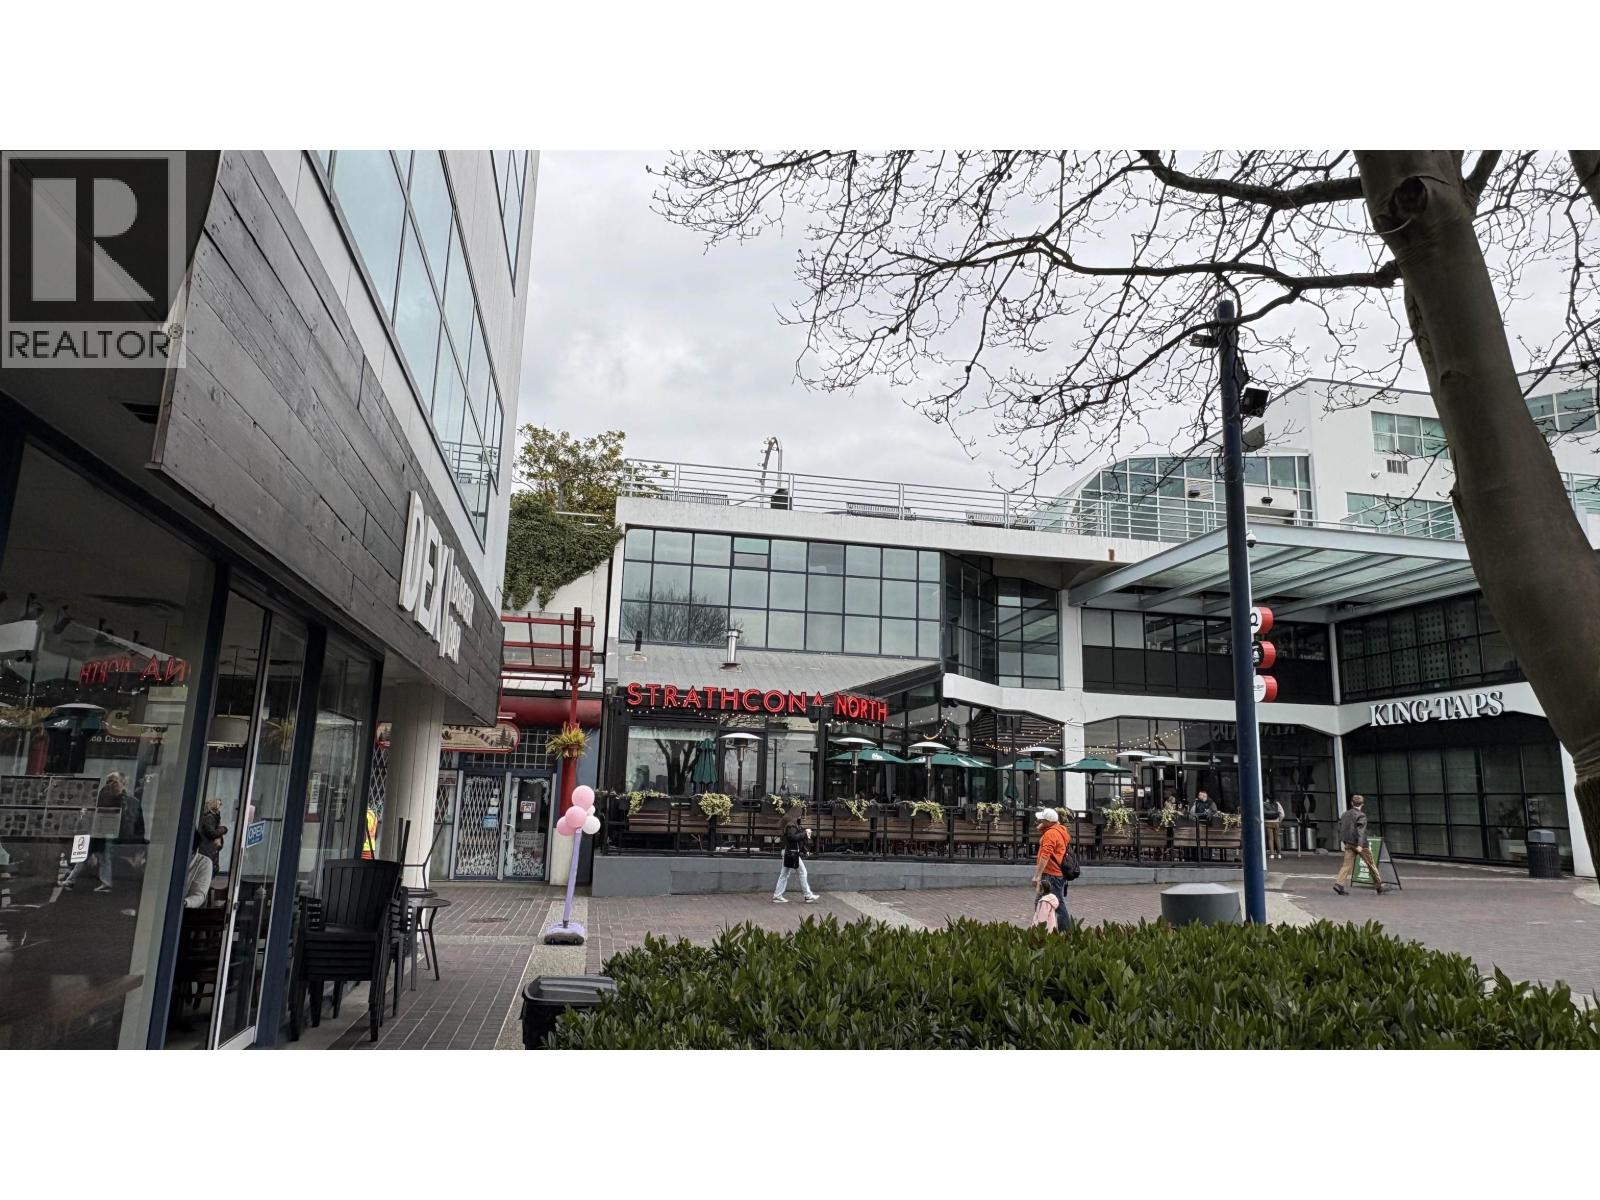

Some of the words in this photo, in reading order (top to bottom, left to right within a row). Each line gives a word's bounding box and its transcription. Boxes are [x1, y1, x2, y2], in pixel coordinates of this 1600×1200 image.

[627, 682, 825, 714] STRATHCONA
[834, 692, 889, 721] NORTH
[1369, 699, 1432, 727] KING
[1434, 691, 1504, 721] TAPS
